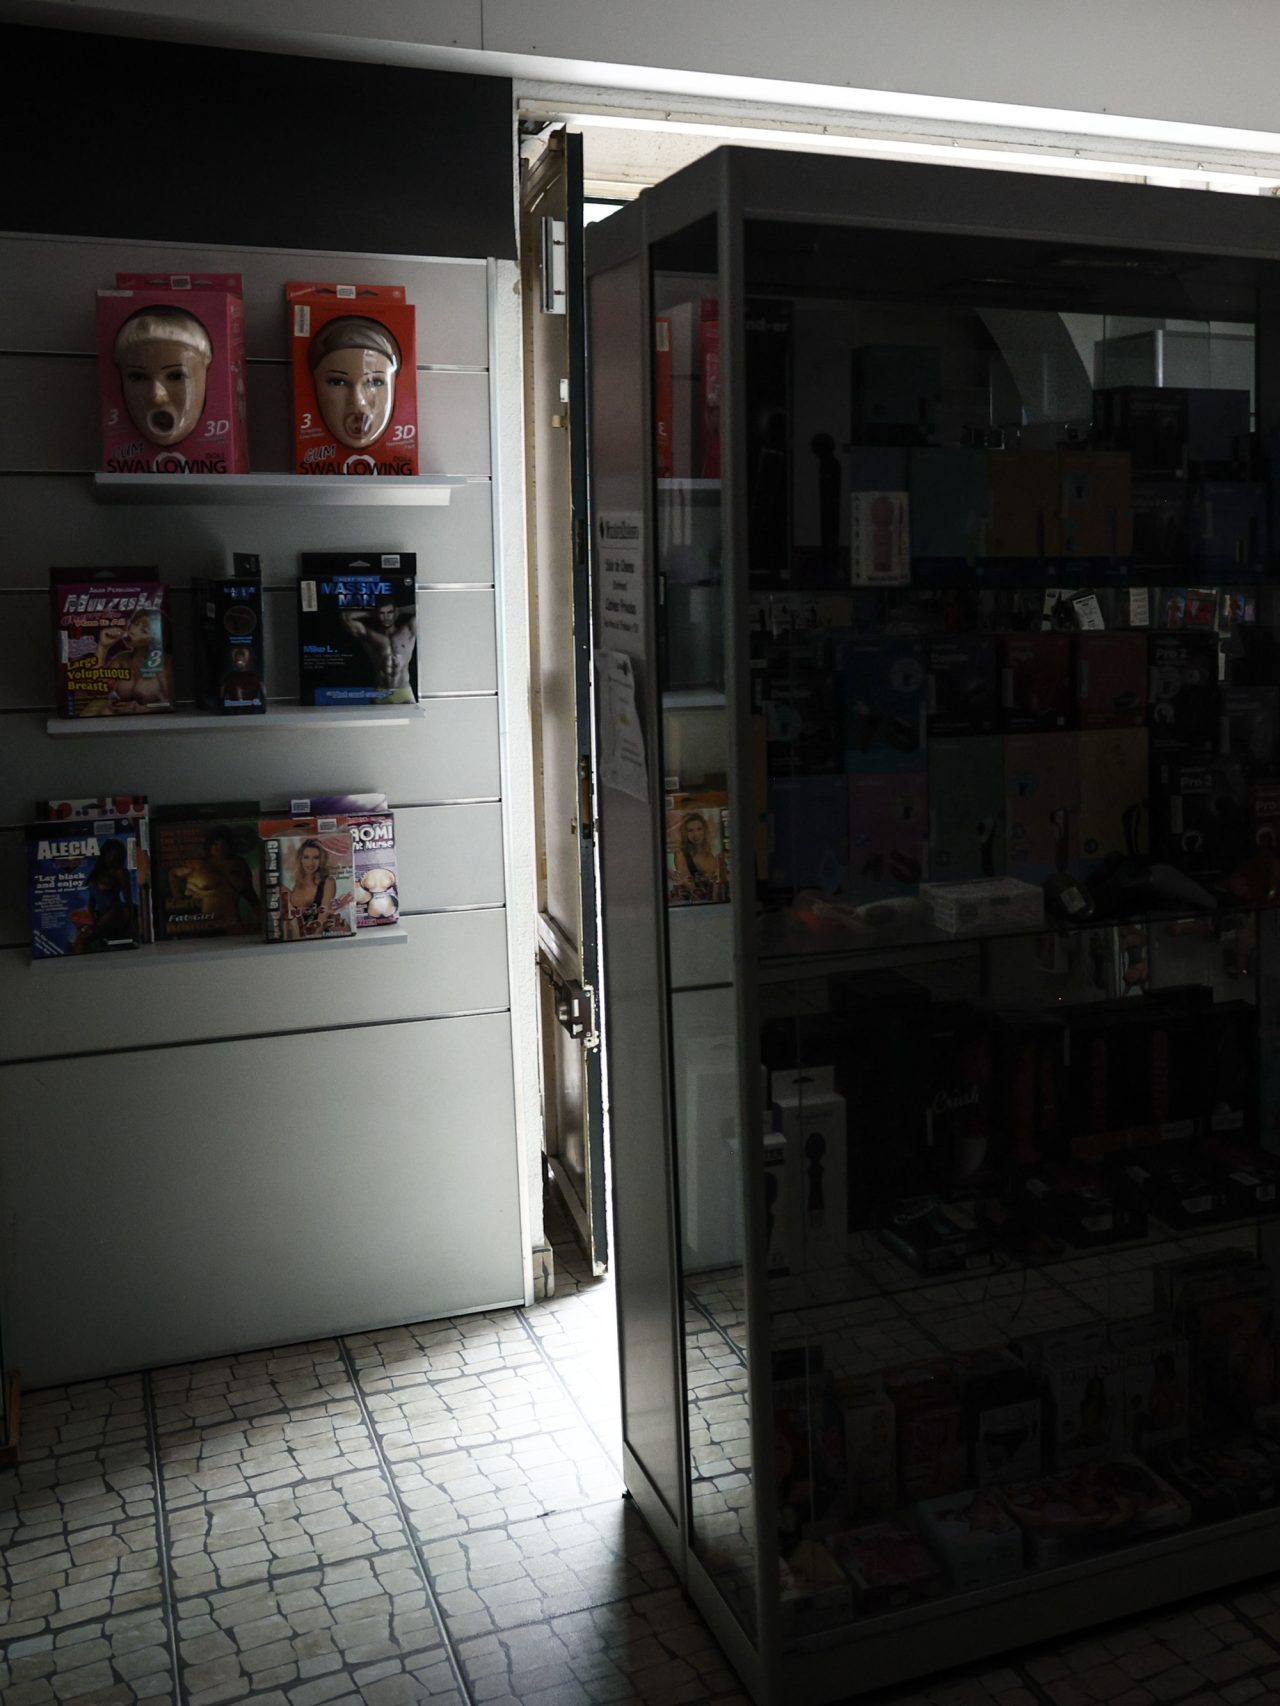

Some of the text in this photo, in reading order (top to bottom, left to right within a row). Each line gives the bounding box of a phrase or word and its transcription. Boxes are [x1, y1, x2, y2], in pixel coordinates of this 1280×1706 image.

[204, 419, 229, 437] 3D
[301, 413, 312, 429] 3
[392, 424, 416, 441] 3D
[107, 458, 227, 474] SWALLOWING
[299, 461, 413, 476] SWALLOWING
[320, 582, 392, 595] MASSIVE
[338, 594, 377, 607] MAN
[67, 656, 98, 670] Large
[148, 650, 162, 667] 3
[67, 667, 131, 680] Voluptuous
[67, 680, 110, 692] Breasts
[37, 837, 101, 861] ALECIA
